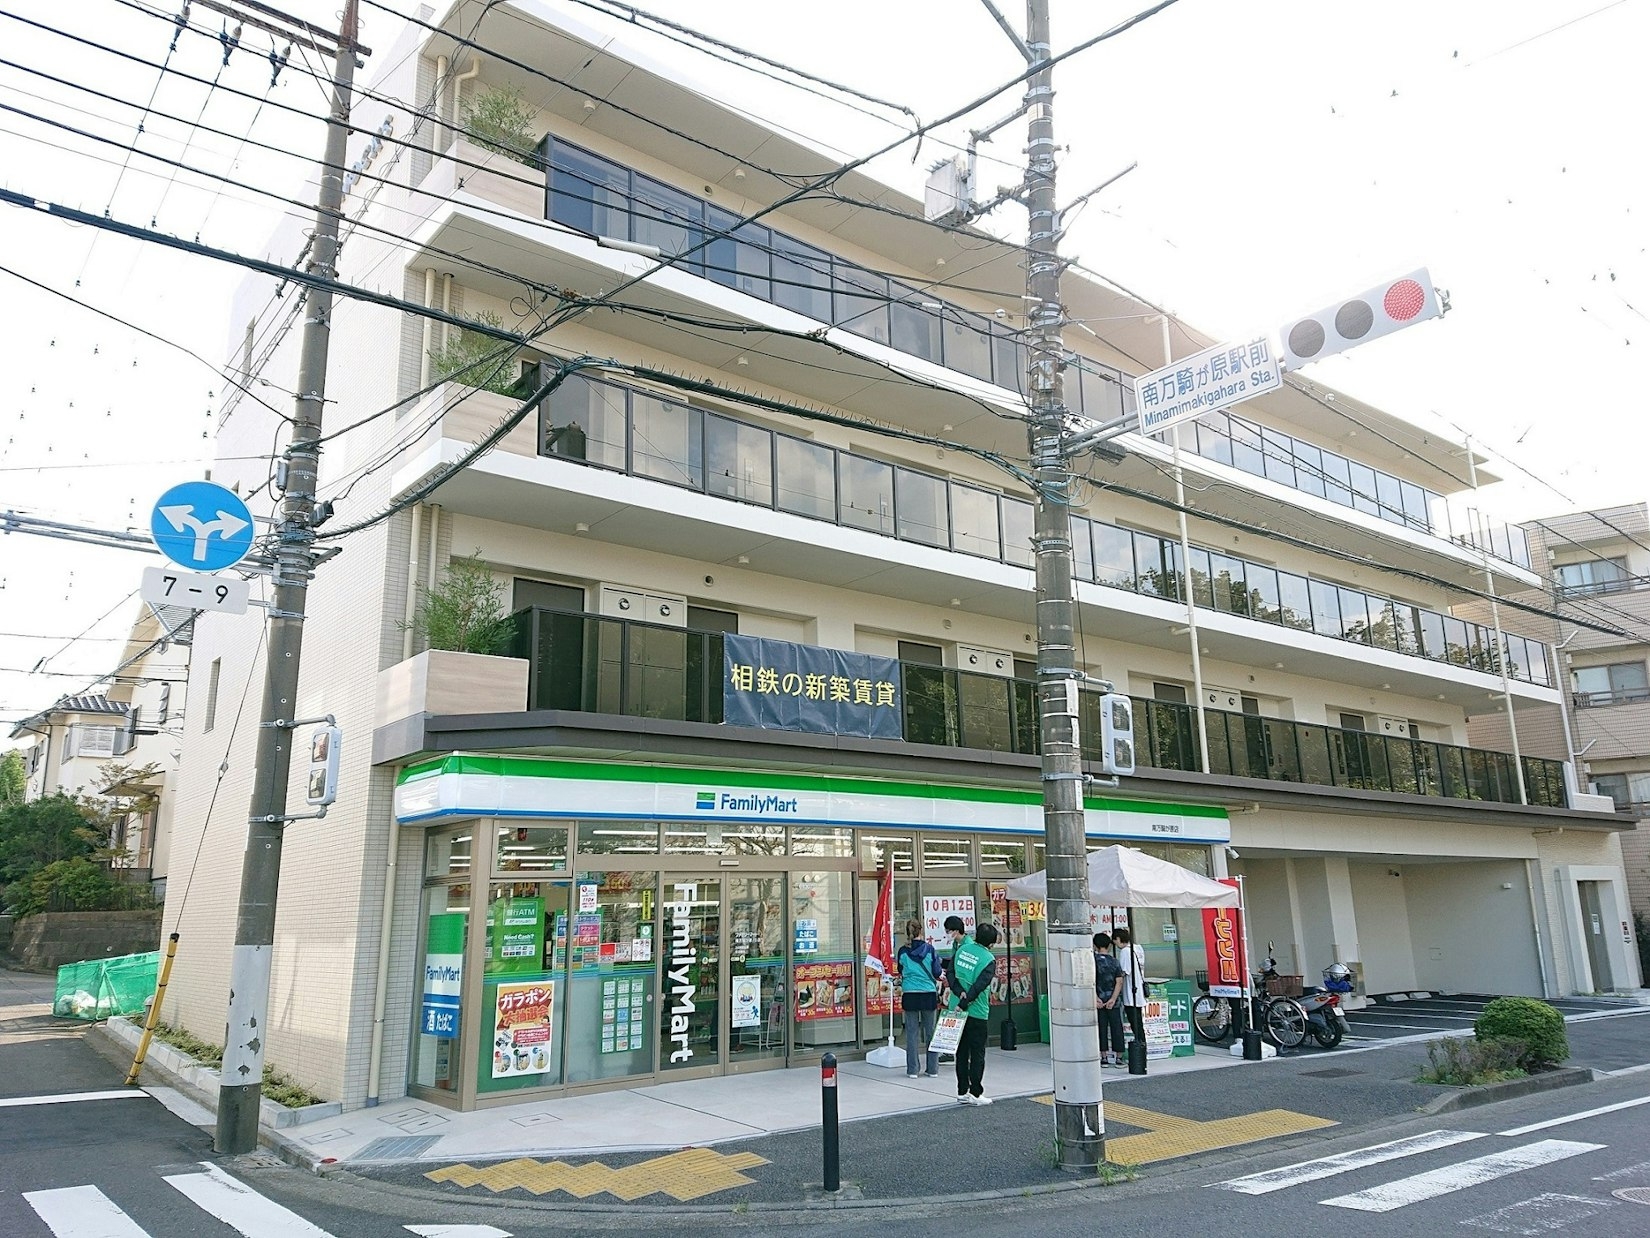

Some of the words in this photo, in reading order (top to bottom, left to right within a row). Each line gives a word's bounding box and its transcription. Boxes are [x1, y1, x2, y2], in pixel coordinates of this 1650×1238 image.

[1142, 338, 1268, 409] 南万騎が原駅前
[1144, 379, 1247, 427] Minamimakigahara
[1250, 370, 1276, 387] Sta.
[731, 663, 896, 707] 相鉄の新築賃貸
[720, 793, 798, 813] FamilyMart
[925, 899, 974, 912] 10月12日
[426, 965, 460, 983] FamilyMart
[668, 883, 698, 1064] FamilyMart
[500, 988, 552, 1011] ガラポン
[427, 1010, 435, 1032] 酒
[436, 1013, 453, 1032] たばこ
[504, 1005, 549, 1026] 大抽選会
